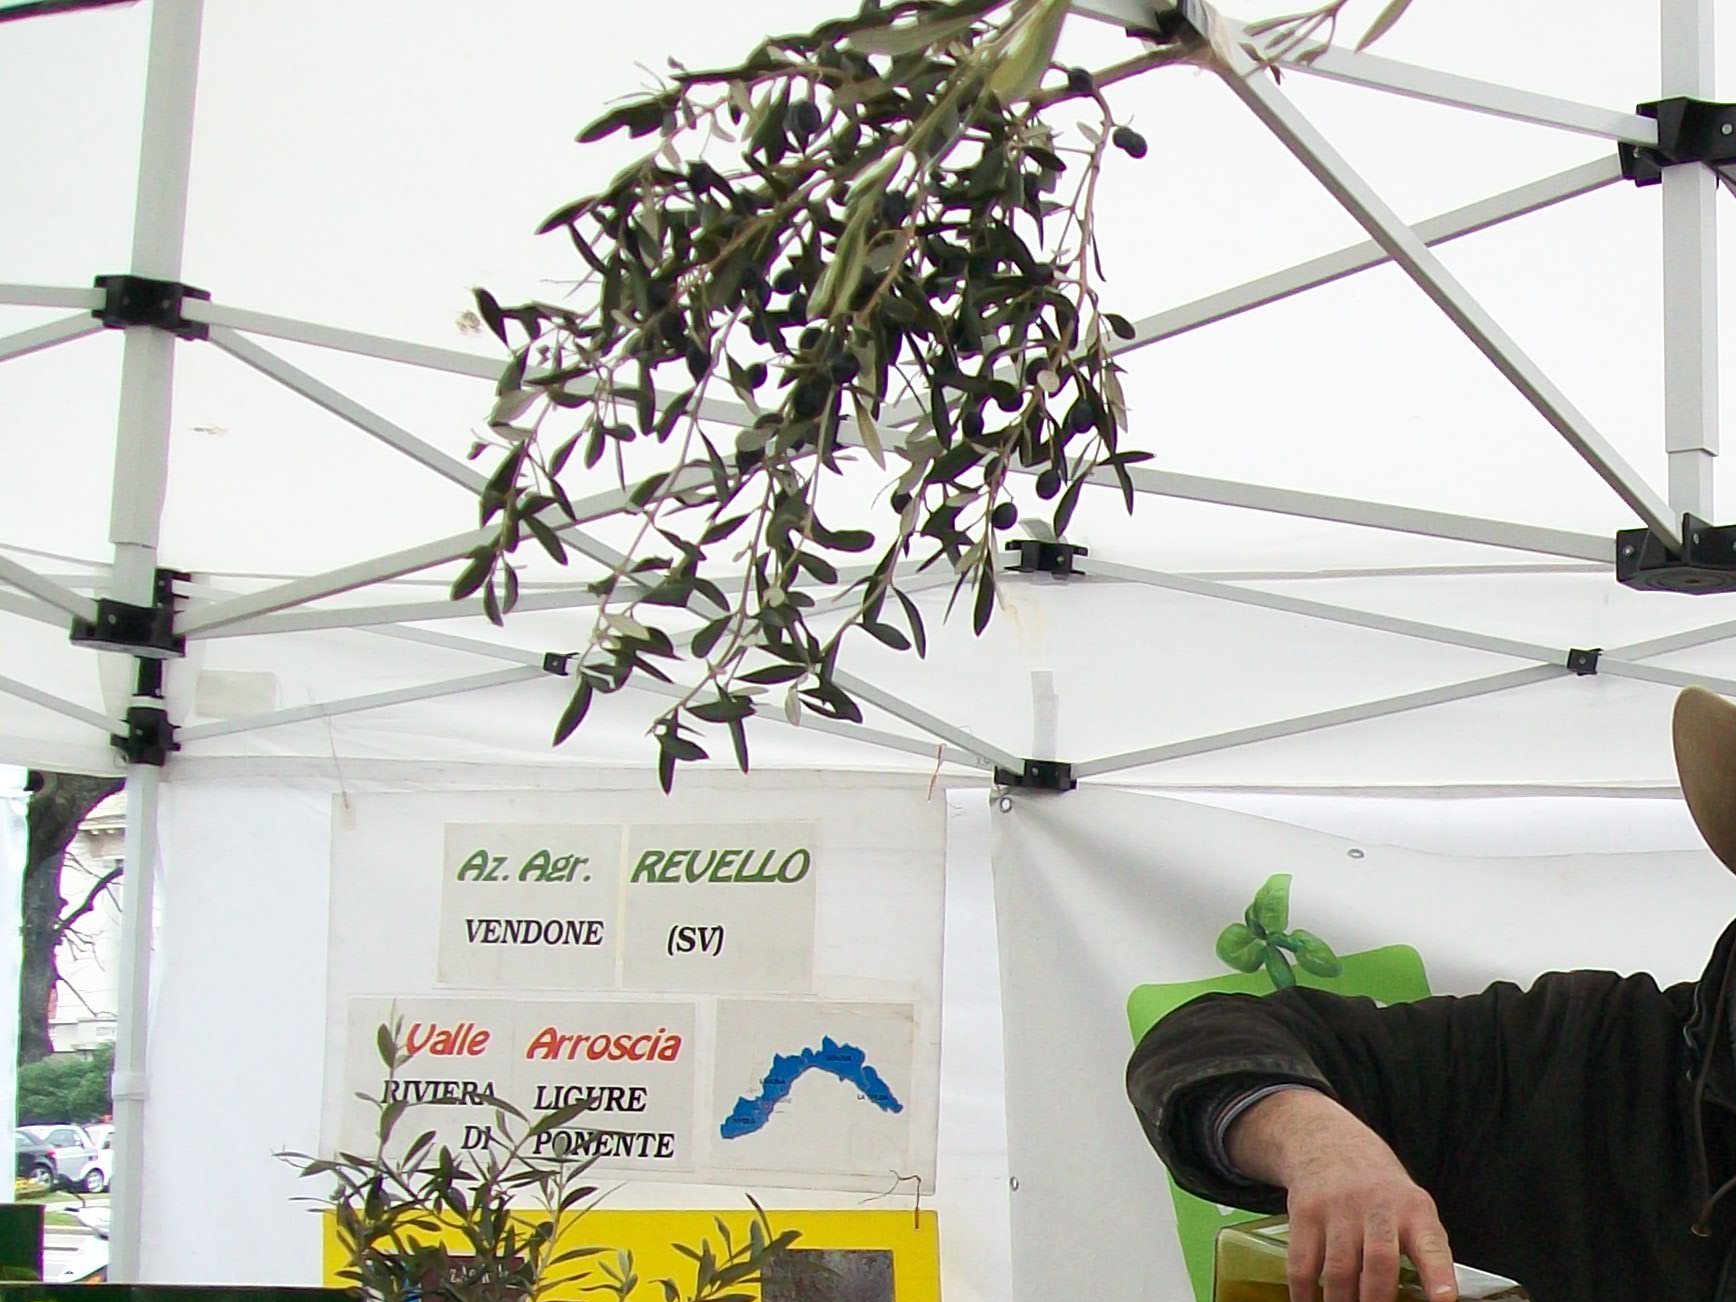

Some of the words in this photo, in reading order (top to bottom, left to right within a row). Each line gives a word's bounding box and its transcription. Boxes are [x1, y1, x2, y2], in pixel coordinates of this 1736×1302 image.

[457, 849, 510, 883] Az.
[518, 849, 591, 884] Agr.
[630, 848, 811, 884] REVELLO
[465, 919, 604, 946] VENDONE
[667, 924, 725, 956] (SV)
[404, 1023, 491, 1056] Valle
[526, 1026, 682, 1062] Arroscia
[381, 1080, 496, 1105] RIVIERA
[534, 1085, 647, 1112] LIGURE
[461, 1126, 492, 1151] DI
[533, 1129, 675, 1159] PONENTE
